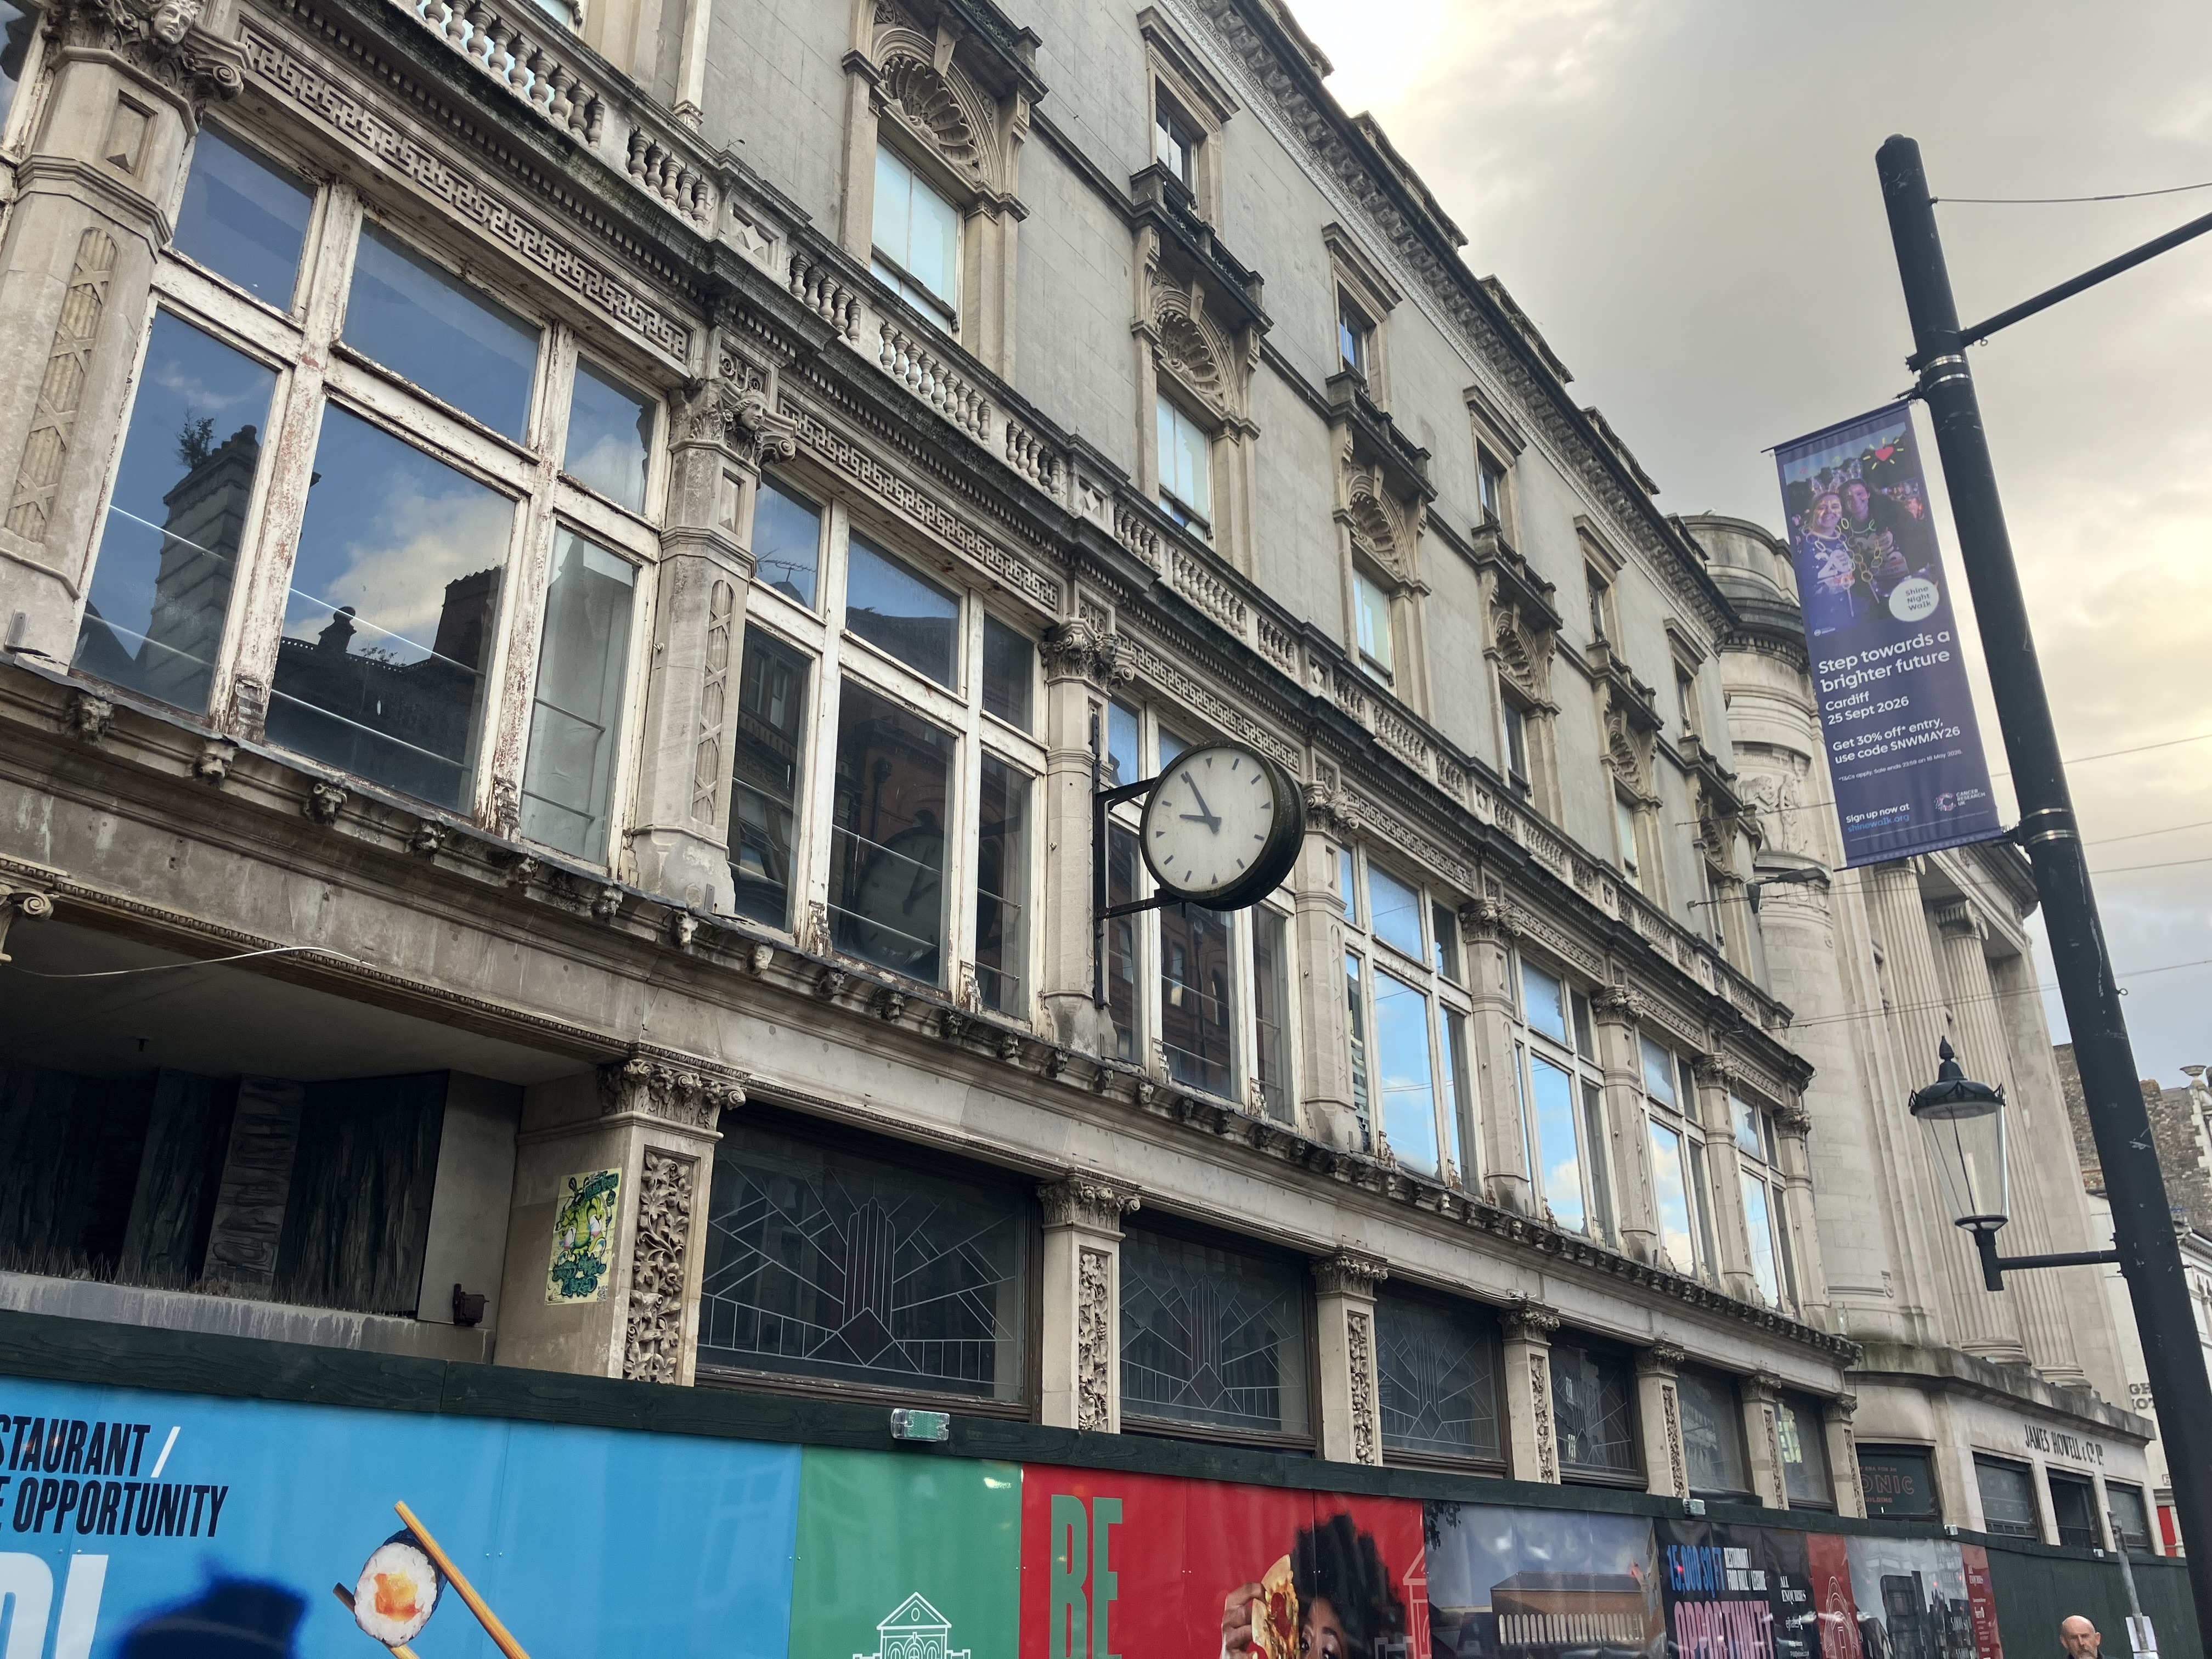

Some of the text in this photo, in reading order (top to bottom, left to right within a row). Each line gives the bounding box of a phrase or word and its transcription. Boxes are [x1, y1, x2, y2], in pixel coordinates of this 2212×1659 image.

[1906, 586, 1928, 596] Shine
[1907, 594, 1930, 603] Night
[1909, 601, 1932, 611] Walk
[1818, 631, 1950, 674] Step towards a
[1820, 651, 1950, 692] brighter future
[1825, 691, 1870, 711] Cardiff
[1827, 696, 1909, 725] 25 Sept 2026
[1832, 739, 1855, 752] Get
[1857, 732, 1882, 746] 30%
[1909, 718, 1943, 733] entry,
[1835, 726, 1961, 764] use code SNWMAY26
[1887, 763, 1901, 771] ends
[1956, 788, 1978, 797] CANCER
[1956, 792, 1986, 801] RESEARCH
[1846, 803, 1910, 823] Sign up now at
[1847, 814, 1910, 833] shinewalk.org
[2024, 1424, 2050, 1453] JAMES
[2051, 1431, 2082, 1460] HOWELL
[12, 1476, 229, 1537] OPPORTUNITY
[1667, 1544, 1725, 1598] 15,000 SQ FT
[1780, 1576, 1790, 1588] ALL
[1781, 1589, 1807, 1605] ENQUIRIES
